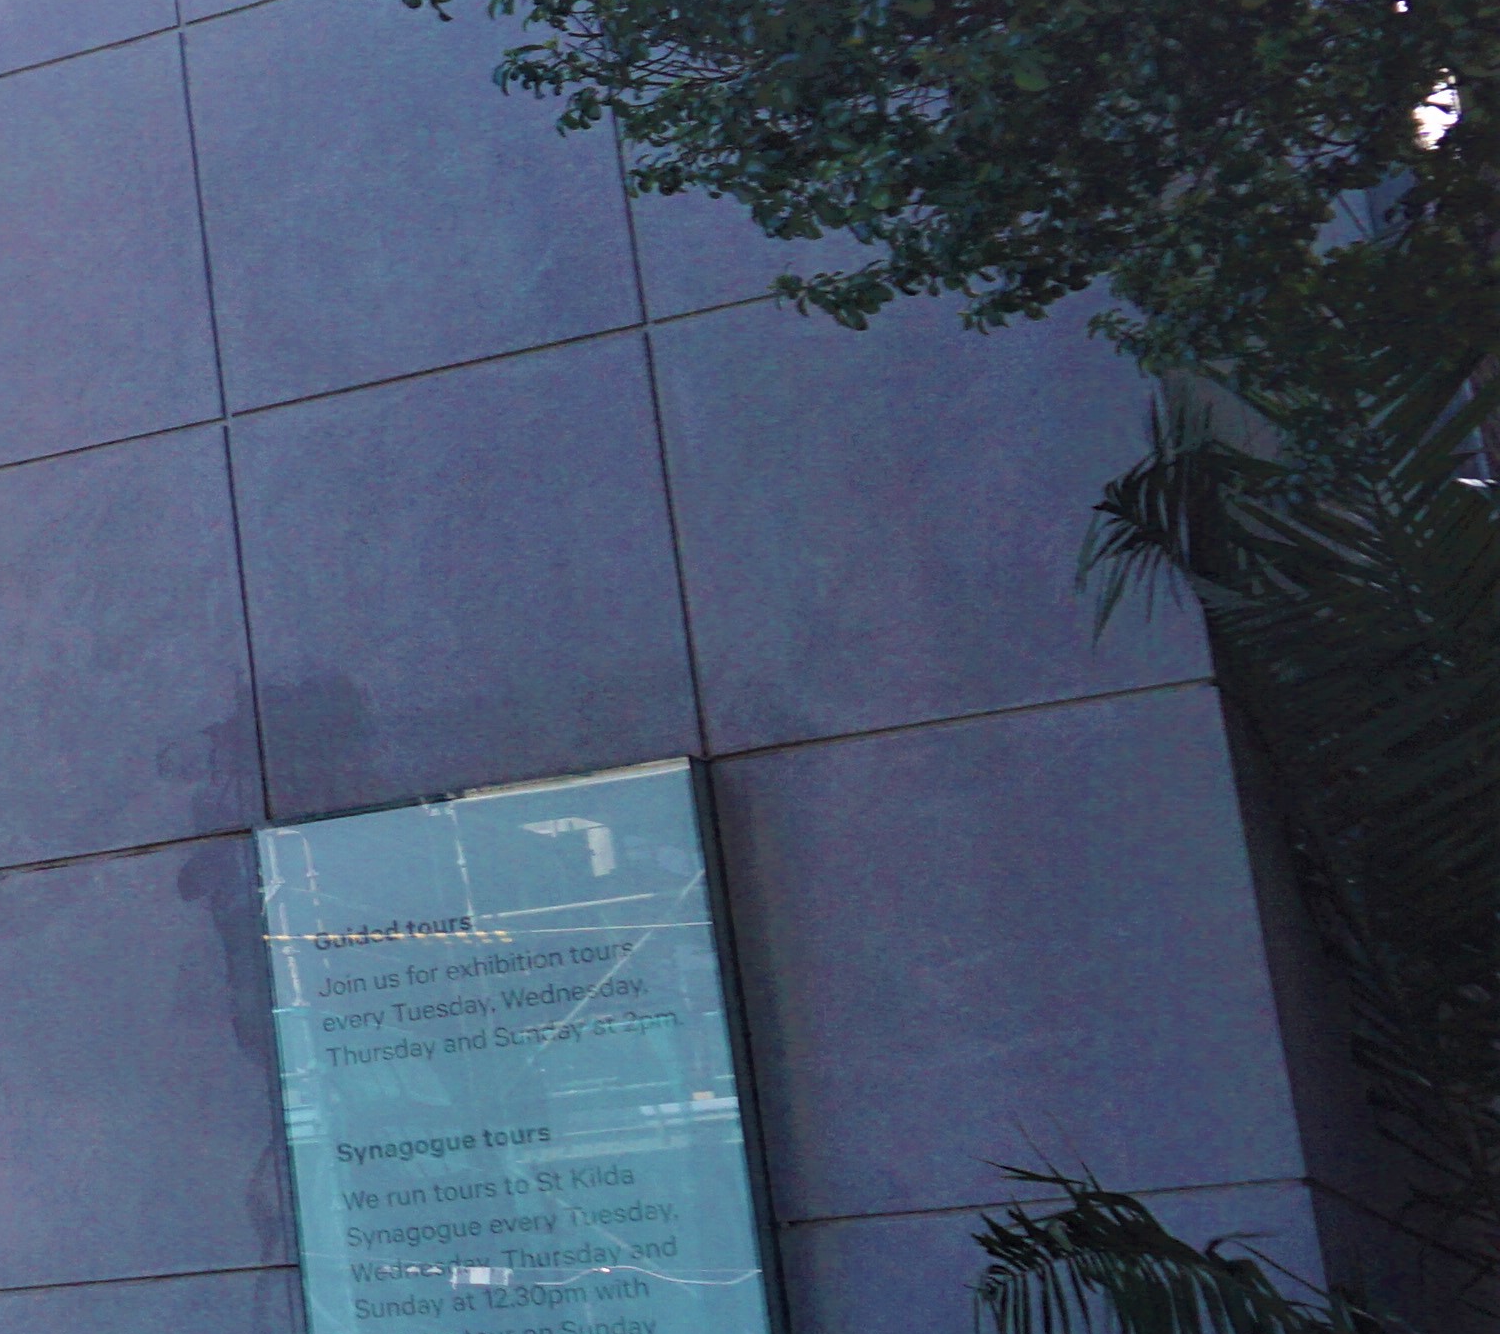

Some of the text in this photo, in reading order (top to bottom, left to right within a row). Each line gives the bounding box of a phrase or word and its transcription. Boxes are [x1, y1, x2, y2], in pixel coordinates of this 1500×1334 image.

[315, 915, 474, 951] Guided tours
[318, 941, 634, 998] Join us for exhibition tours
[322, 1010, 386, 1033] every
[325, 1036, 436, 1068] Thursday
[443, 1028, 488, 1055] and
[494, 1018, 583, 1048] Sunday
[336, 1125, 551, 1166] Synagogue tours
[342, 1163, 636, 1211] We run tours to St Kilda
[347, 1219, 482, 1251] Synagogue
[489, 1212, 557, 1235] every
[501, 1240, 622, 1268] Thursday
[630, 1234, 678, 1260] and
[354, 1277, 650, 1320] Sunday at 12.30pm with
